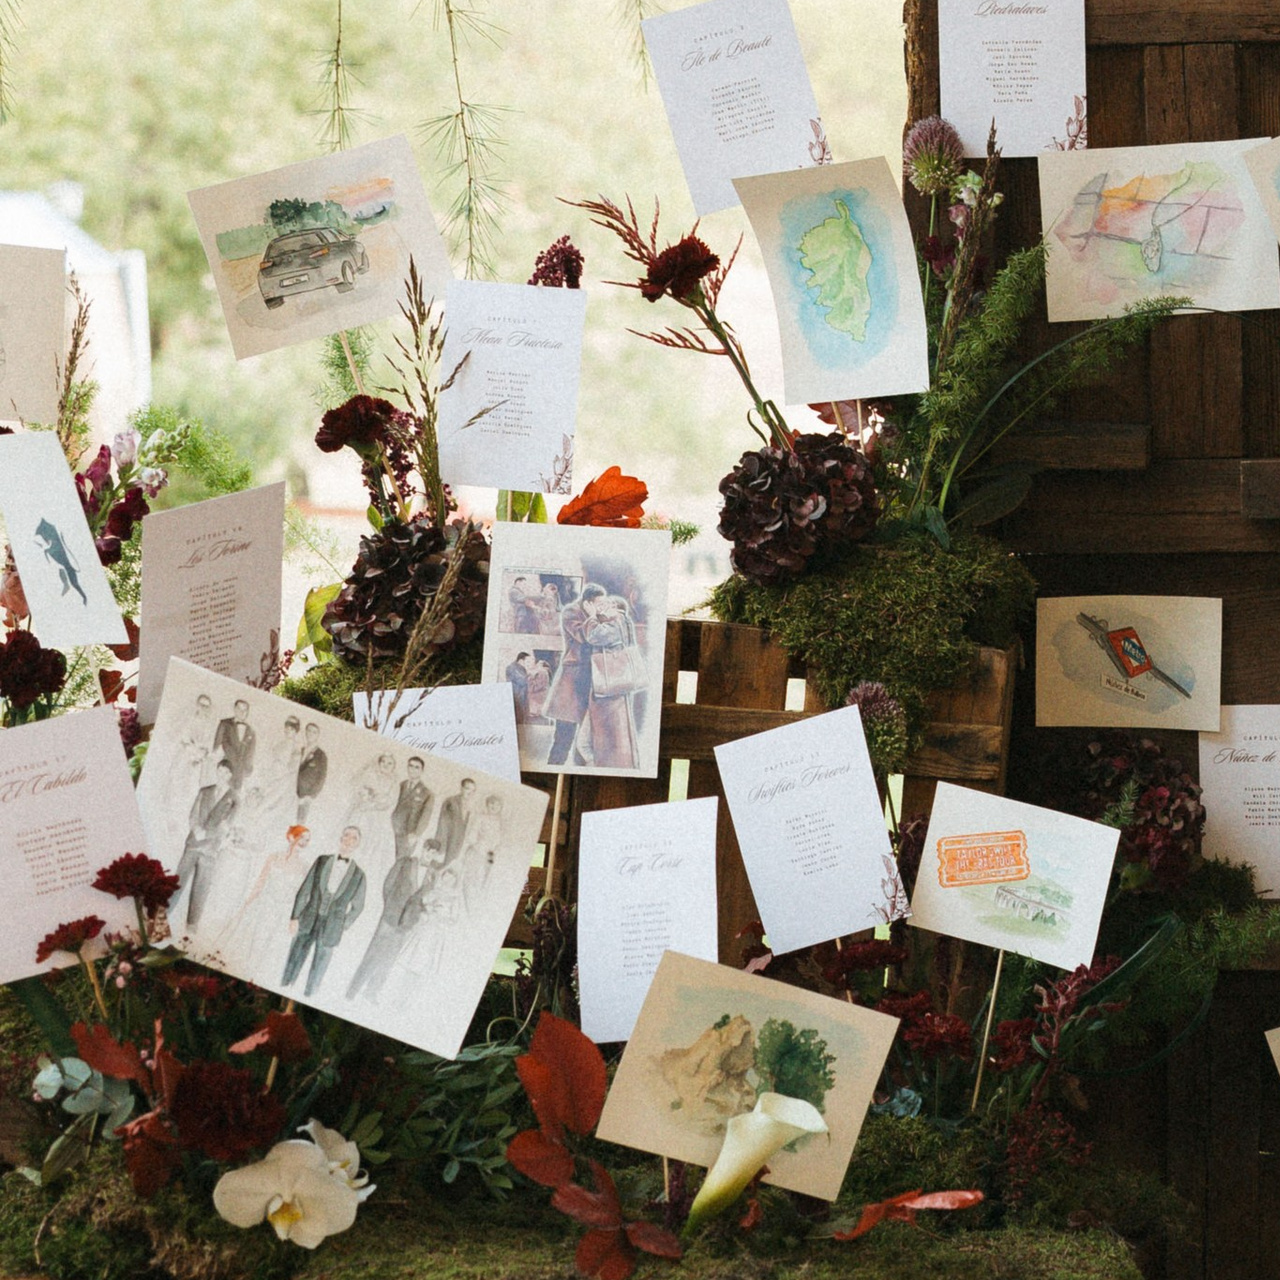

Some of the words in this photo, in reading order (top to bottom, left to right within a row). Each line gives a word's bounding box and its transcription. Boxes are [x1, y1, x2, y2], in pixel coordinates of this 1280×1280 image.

[973, 0, 1048, 18] Piedralaves
[708, 47, 723, 64] de
[440, 728, 504, 751] Disaster
[1213, 747, 1259, 764] Núñez
[1261, 750, 1276, 762] de
[800, 763, 852, 789] Forever
